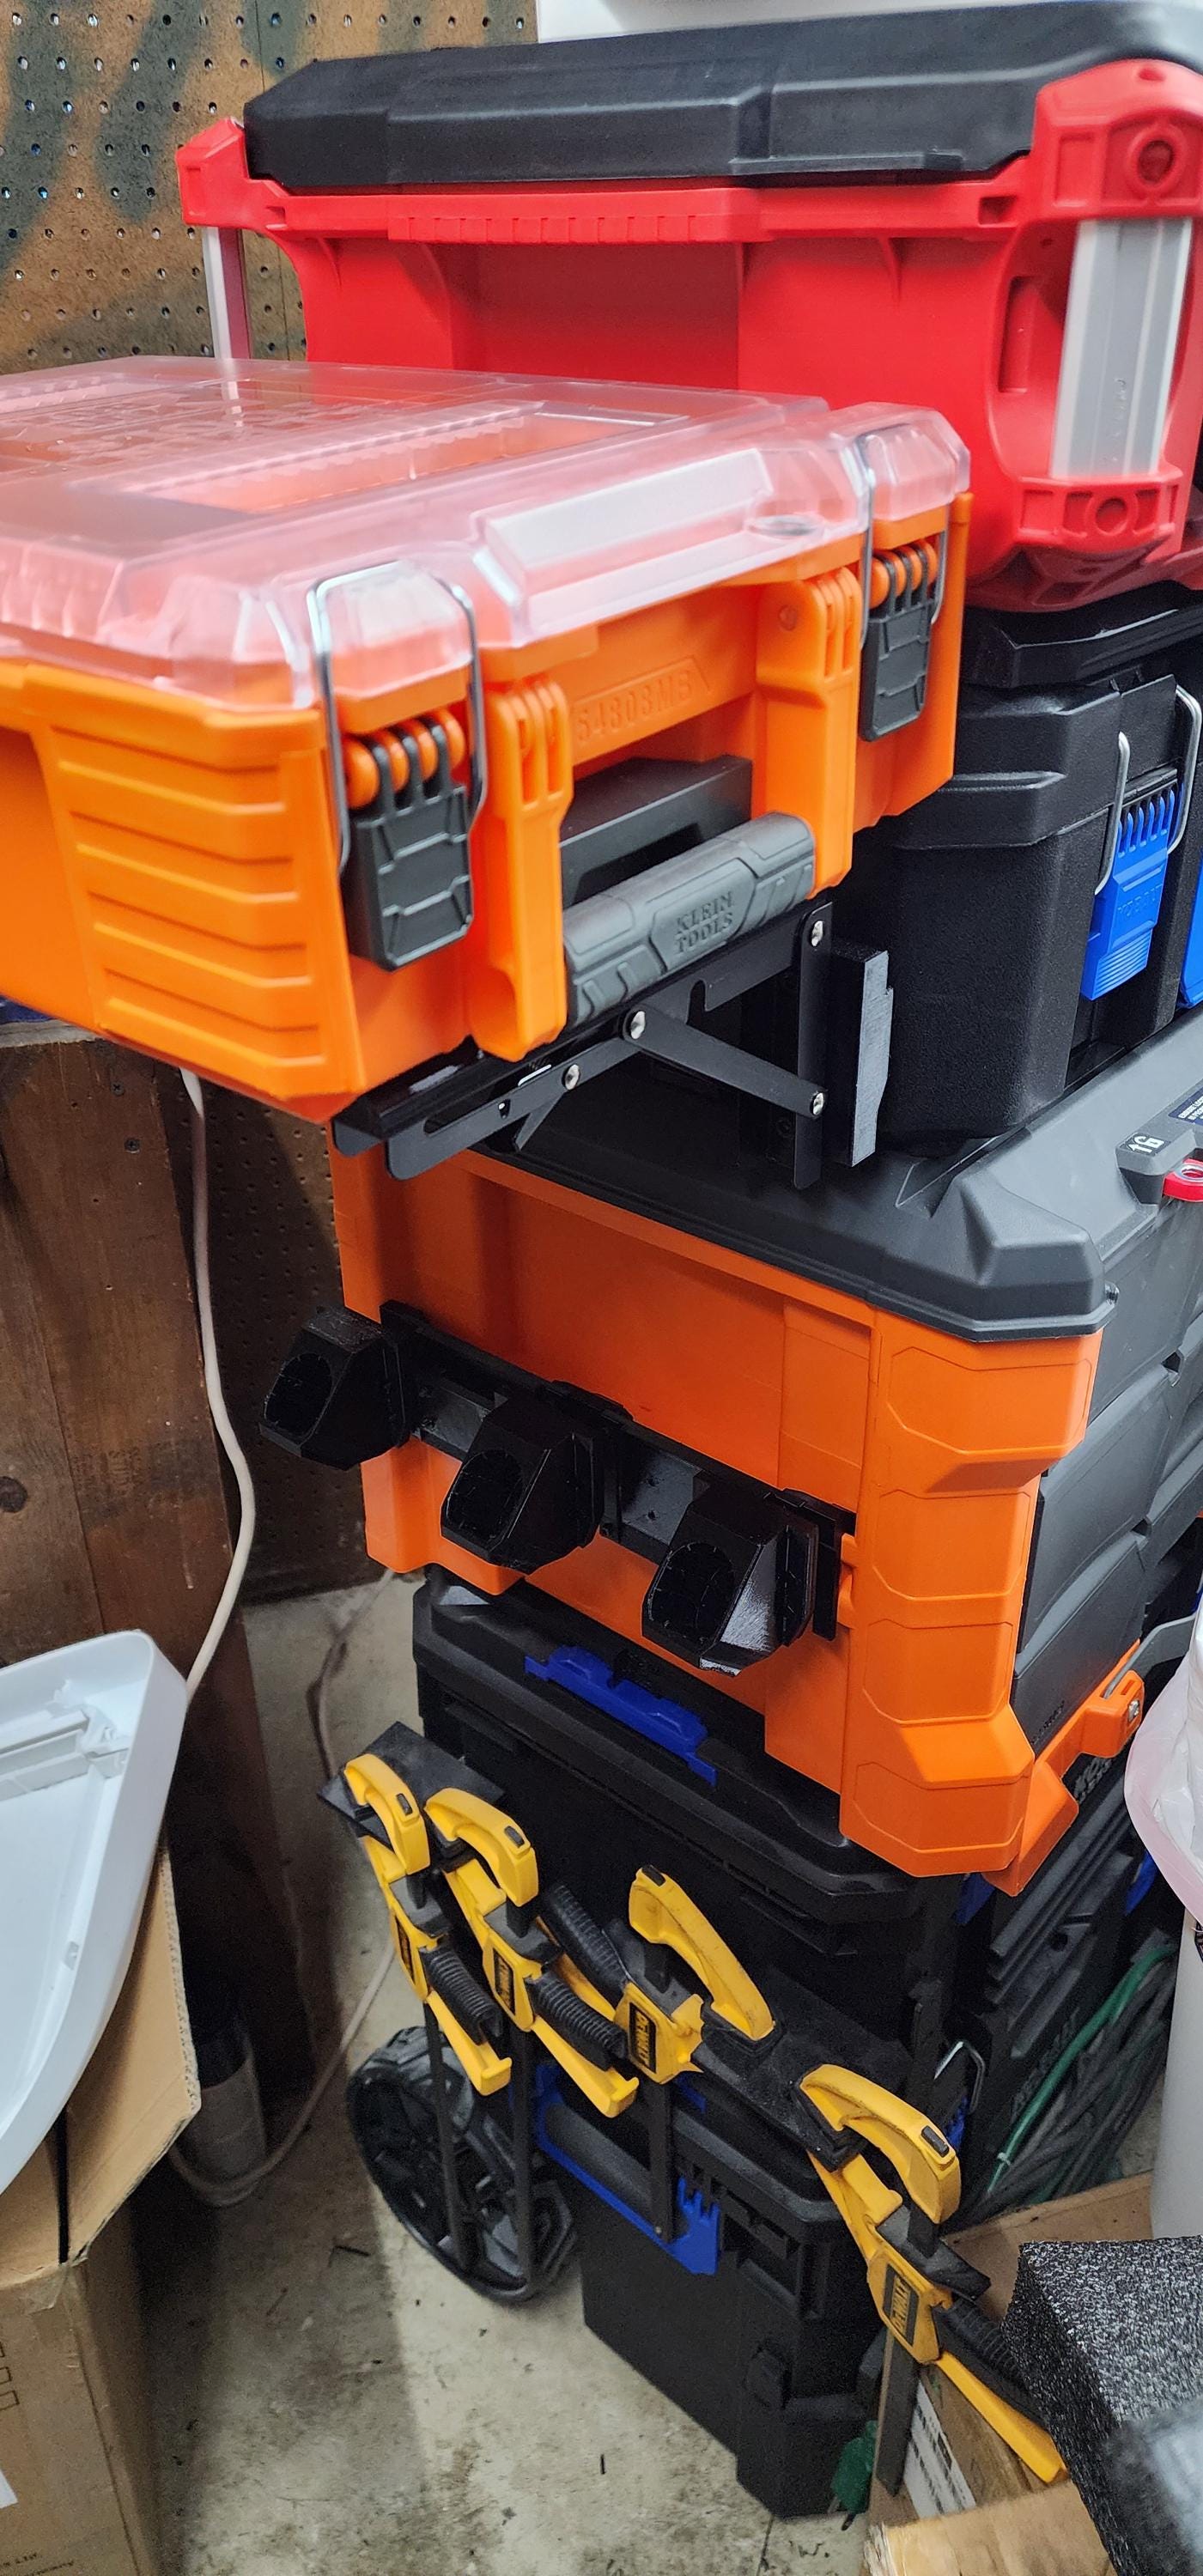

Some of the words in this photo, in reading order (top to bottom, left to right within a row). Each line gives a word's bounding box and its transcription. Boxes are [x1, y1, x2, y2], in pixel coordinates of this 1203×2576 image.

[673, 911, 734, 955] TOOLS
[677, 890, 735, 931] KLEIN
[635, 2008, 651, 2069] DEWALT
[889, 2274, 911, 2336] DEWALT
